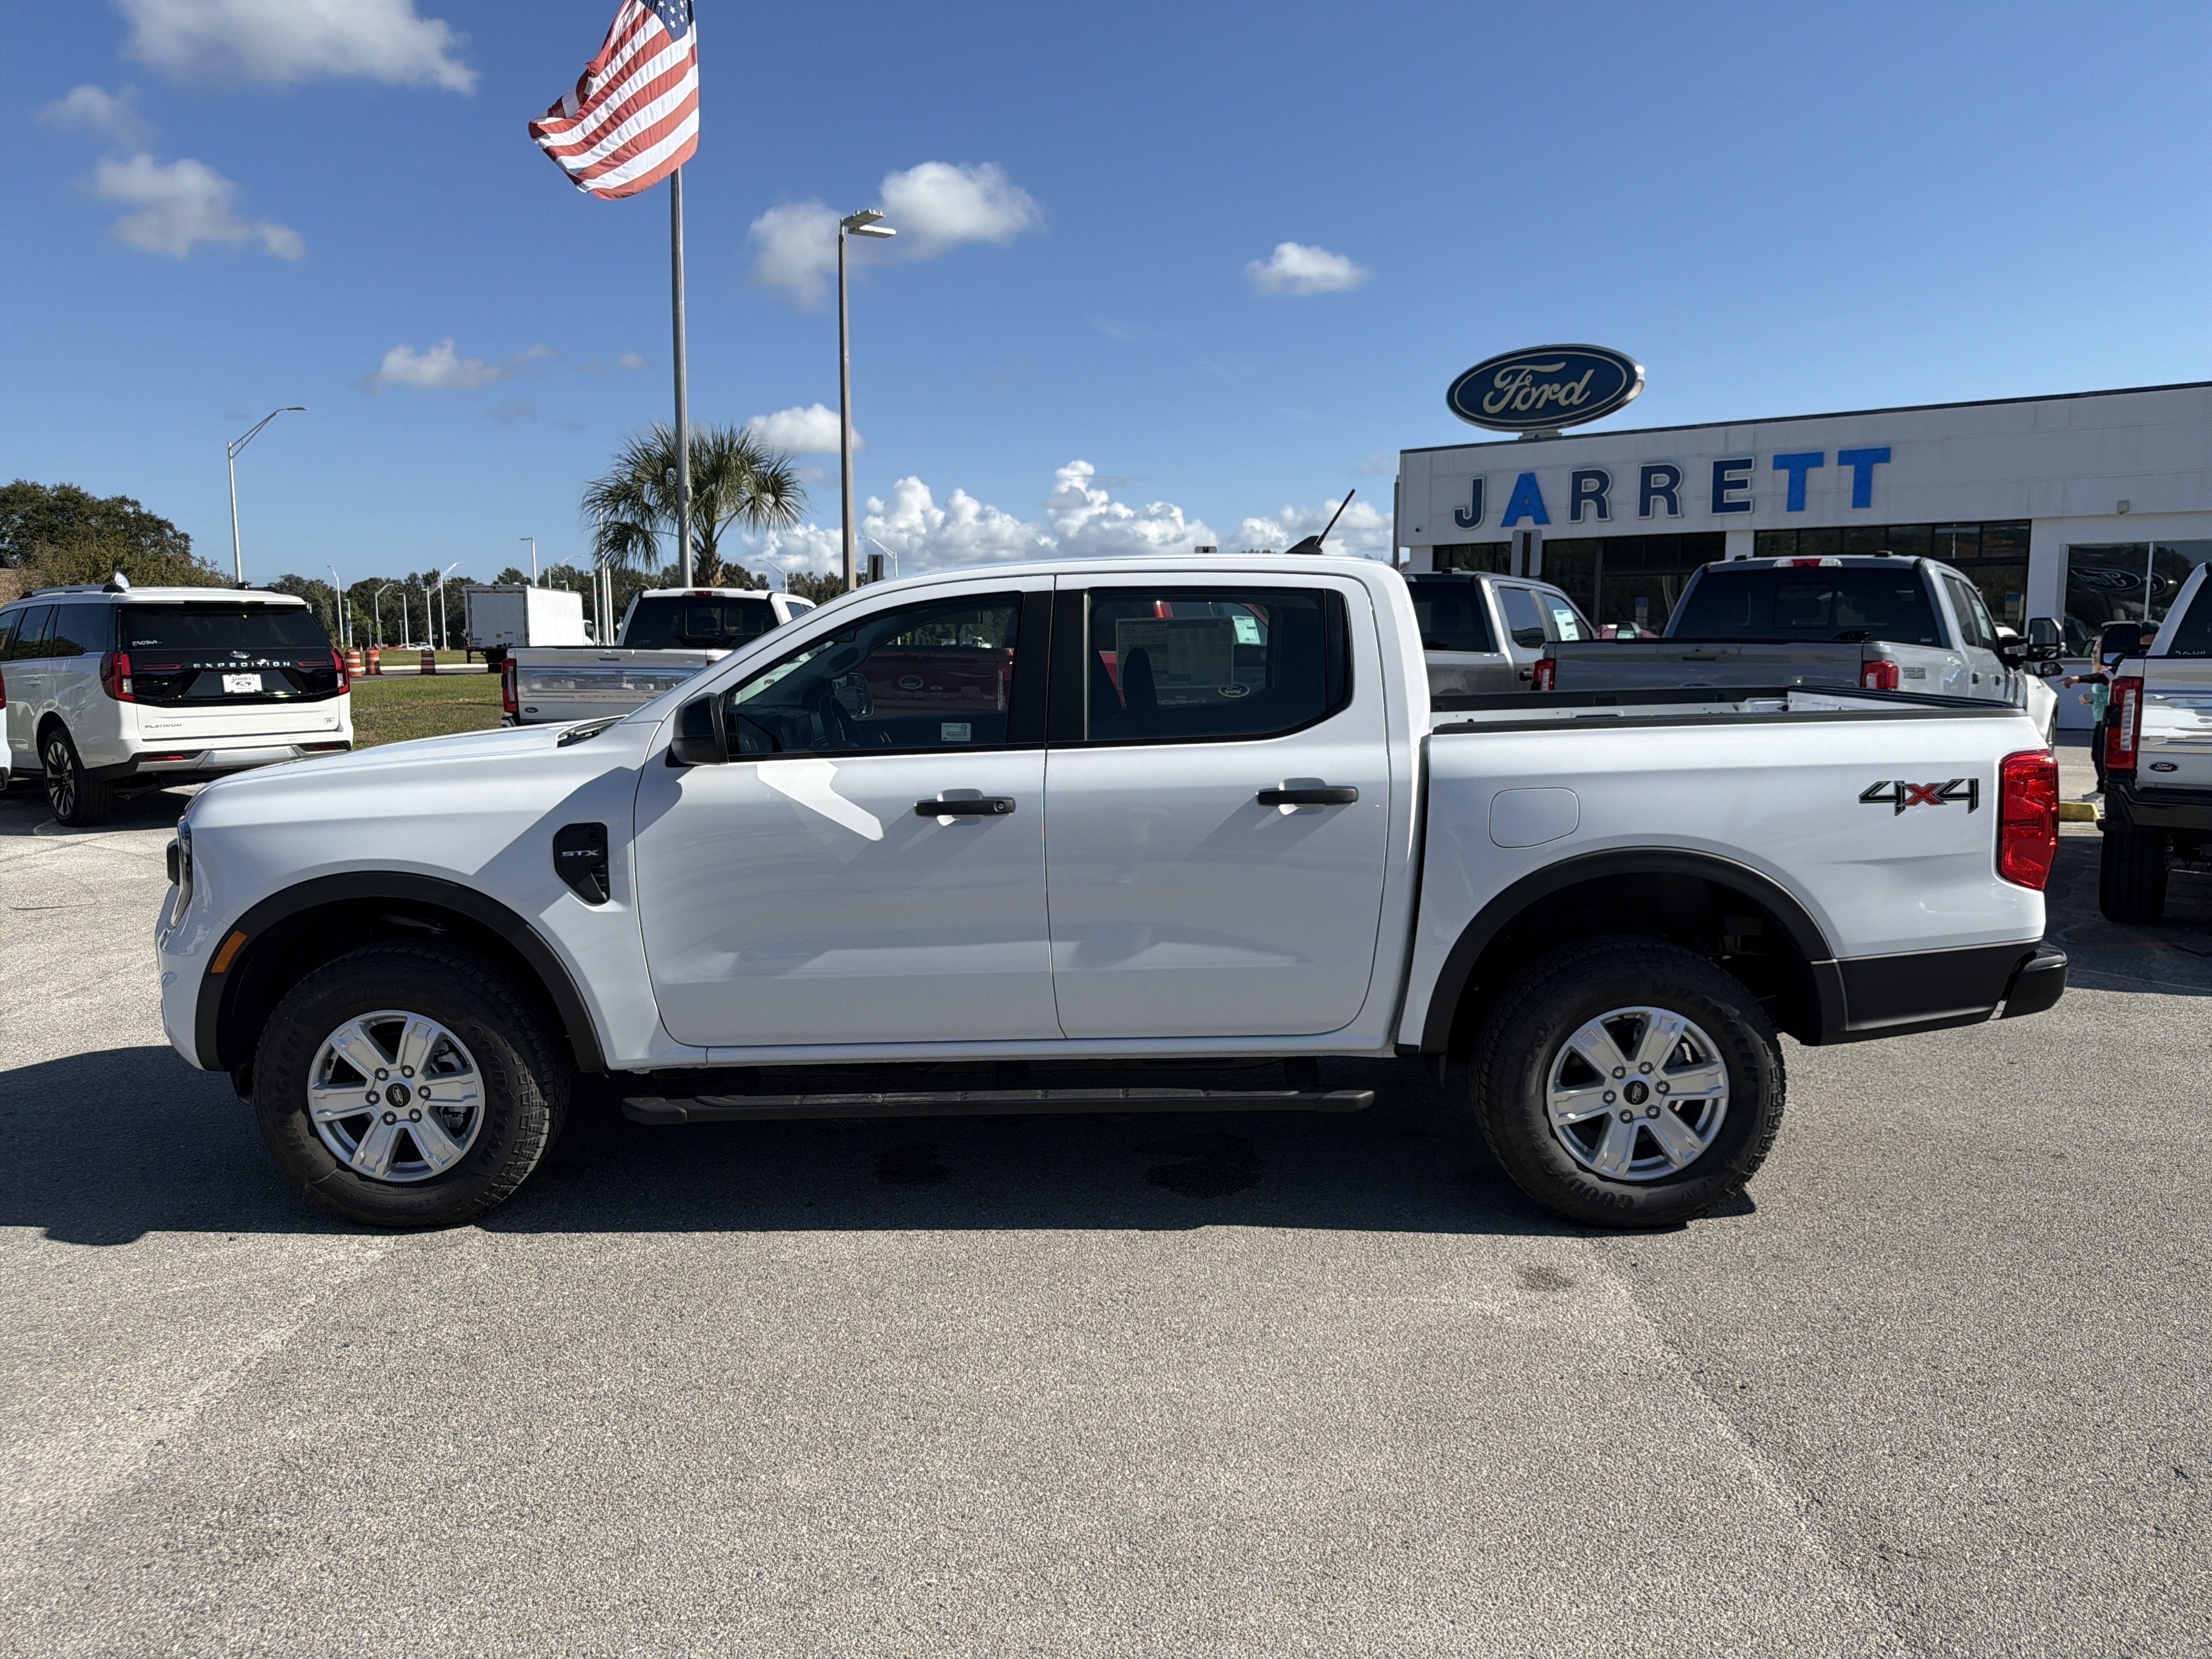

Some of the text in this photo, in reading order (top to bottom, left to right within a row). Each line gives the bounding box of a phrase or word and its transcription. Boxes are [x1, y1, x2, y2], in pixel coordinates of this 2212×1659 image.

[1482, 362, 1595, 414] Ford
[1452, 447, 1892, 531] JARRETT
[562, 849, 600, 857] STX
